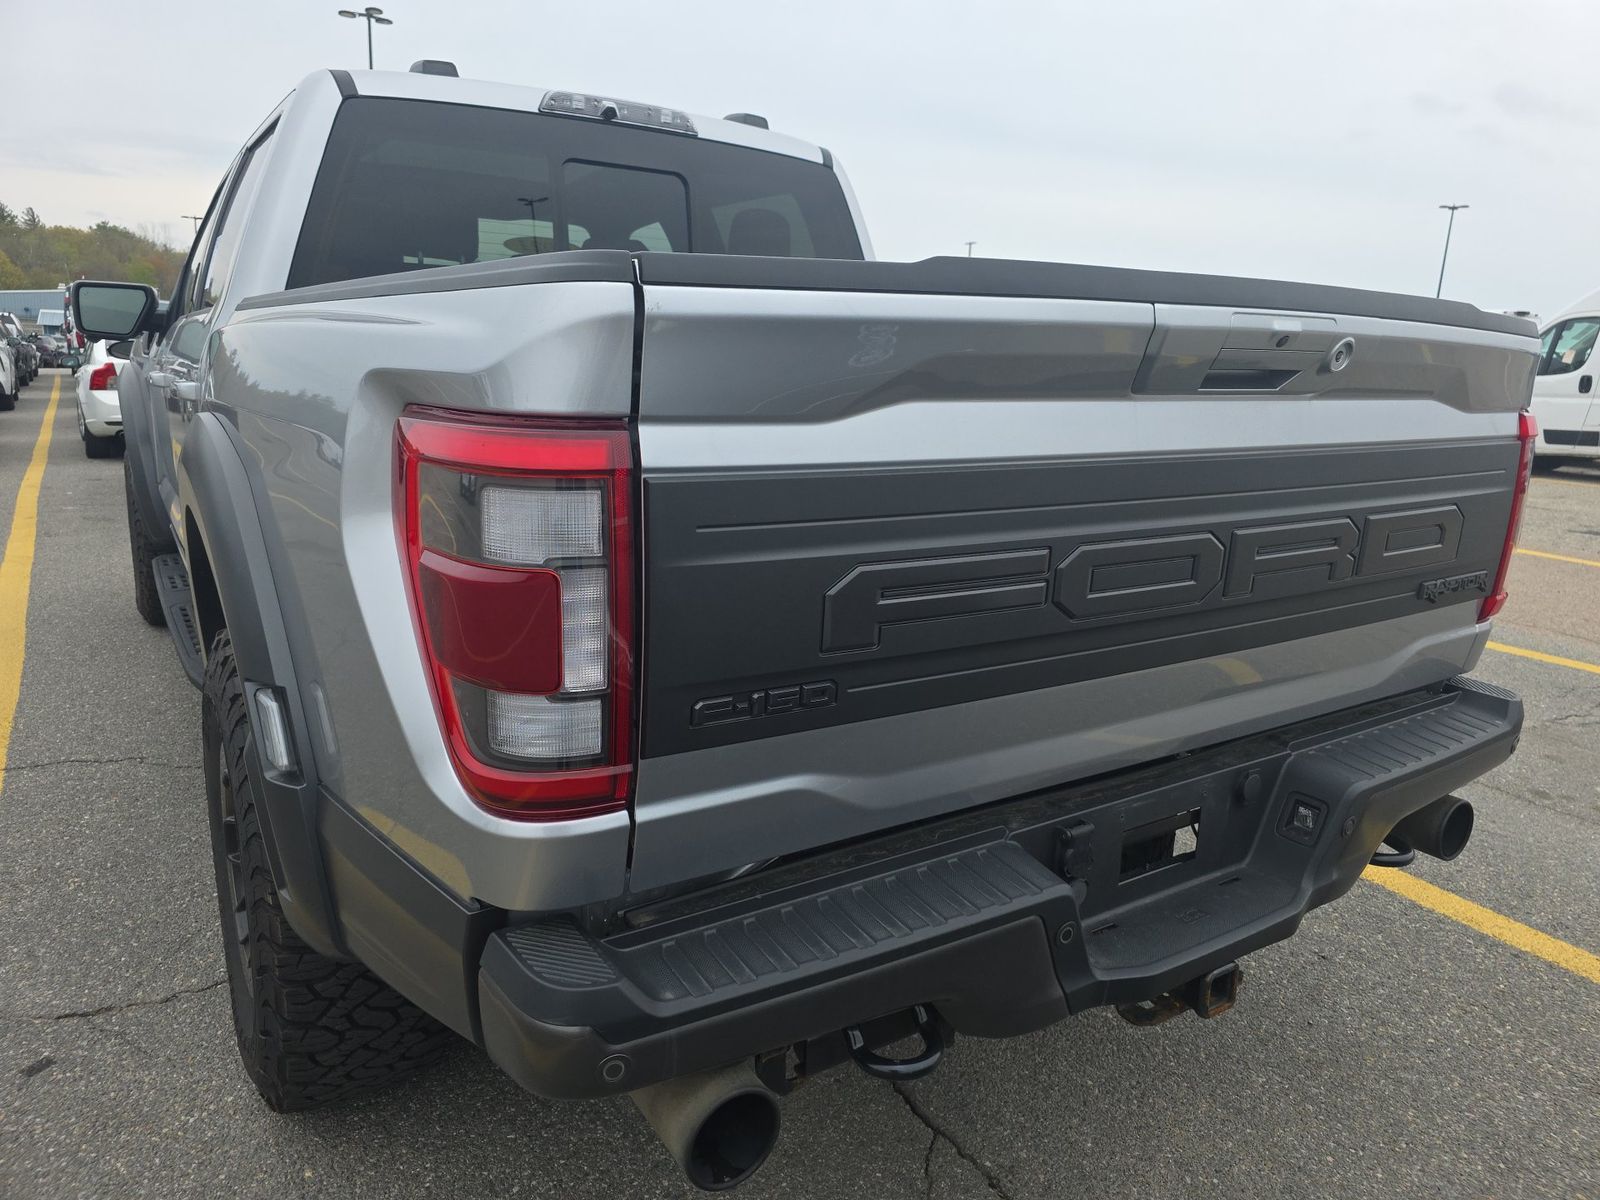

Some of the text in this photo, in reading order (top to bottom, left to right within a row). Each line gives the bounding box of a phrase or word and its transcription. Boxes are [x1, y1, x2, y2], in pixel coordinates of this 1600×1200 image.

[821, 505, 1464, 656] FORD
[1417, 570, 1488, 603] RAPTOR
[691, 679, 838, 728] F-150
